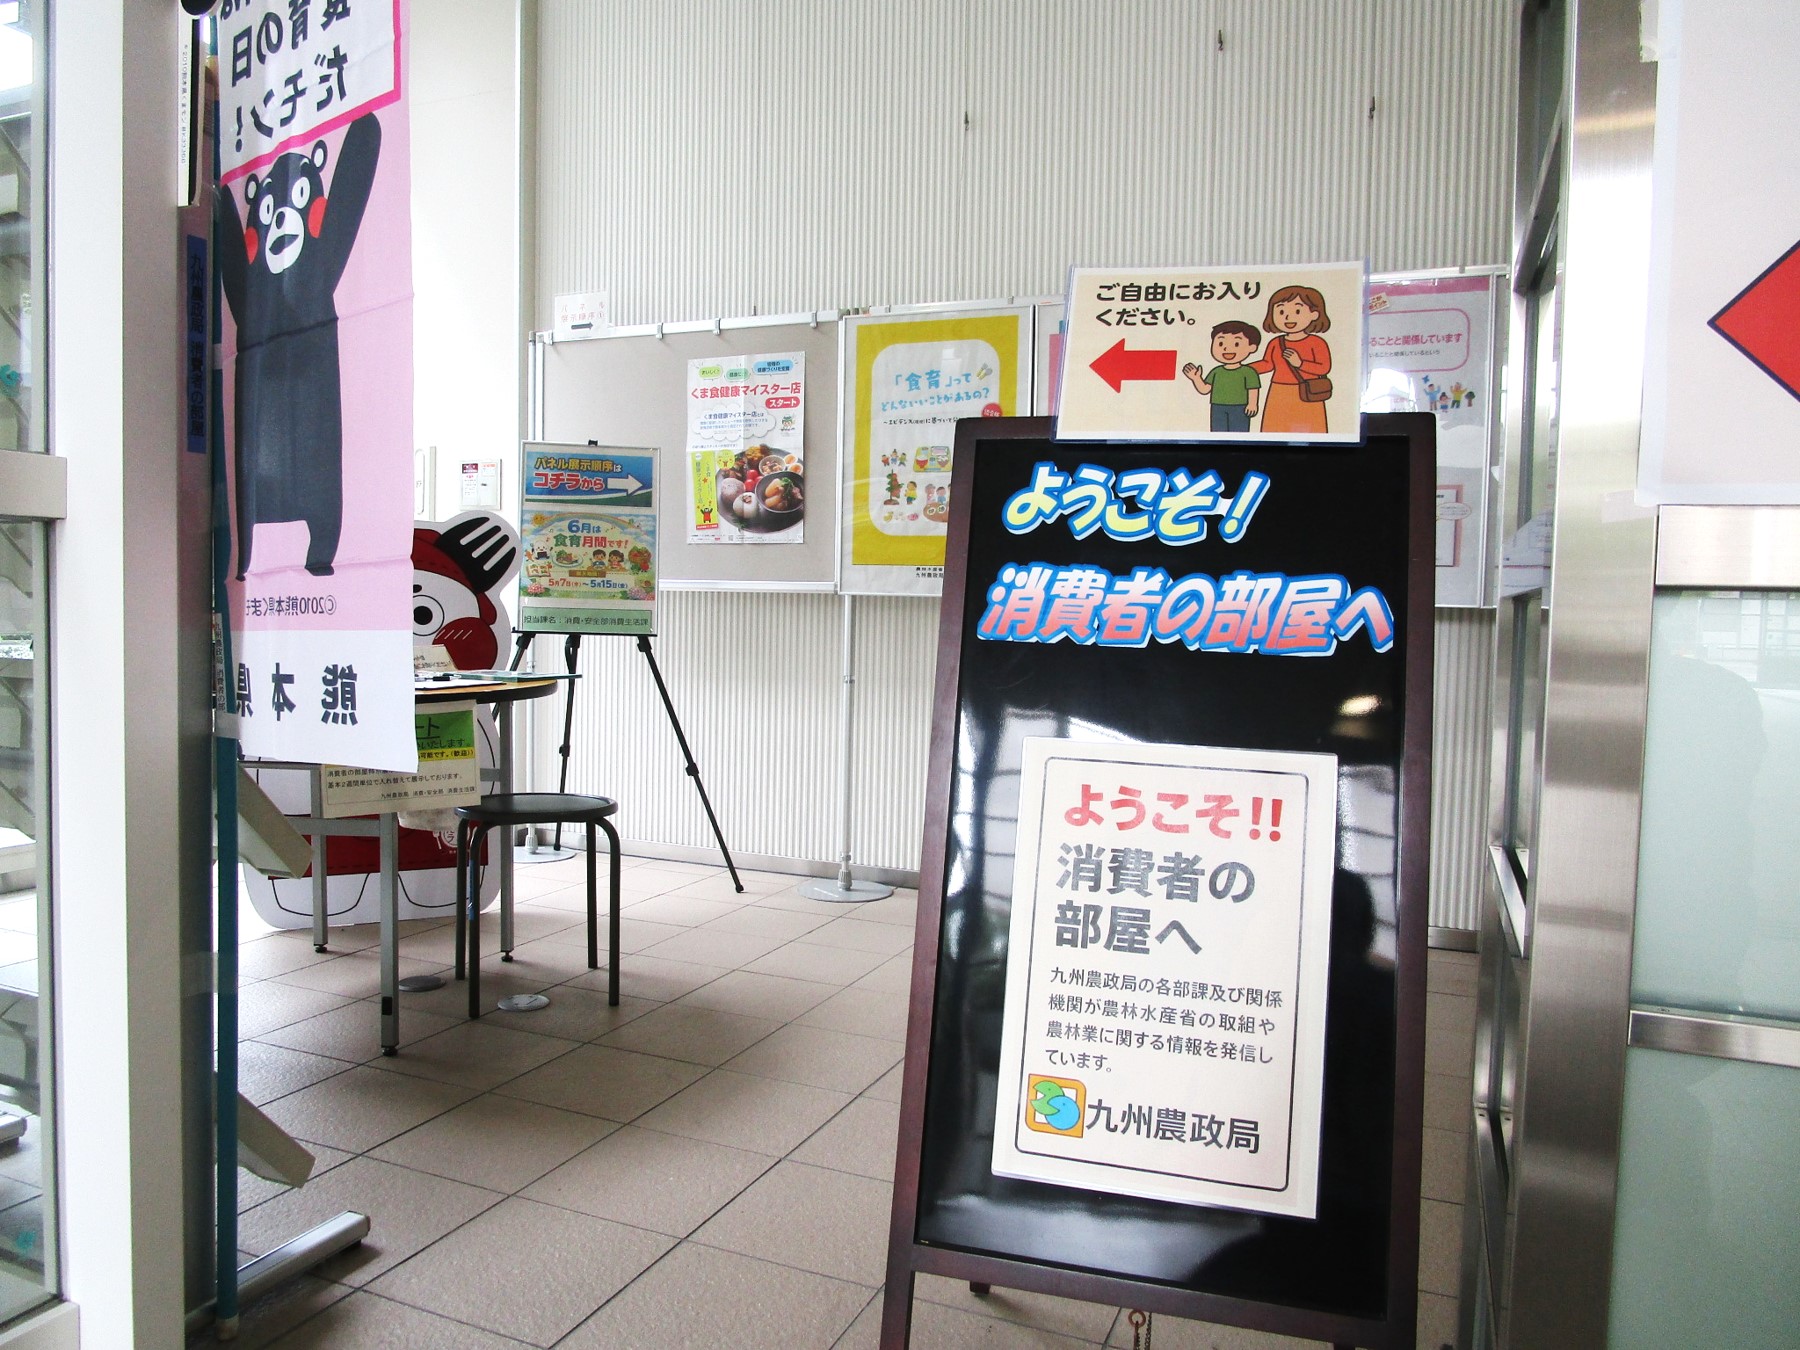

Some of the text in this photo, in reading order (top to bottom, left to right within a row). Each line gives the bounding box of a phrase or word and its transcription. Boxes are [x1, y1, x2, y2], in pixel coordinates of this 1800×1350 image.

[1096, 281, 1261, 302] ご自由にお入り
[1095, 307, 1197, 327] ください。
[691, 382, 801, 399] くま食健康マイスター店
[894, 369, 972, 392] 「食育」って
[769, 399, 797, 408] スタート
[881, 387, 990, 412] どんないいことがあるの?
[535, 458, 623, 472] パネル展示順序は
[533, 472, 605, 491] コチラから
[1002, 461, 1270, 546] ようこそ!
[567, 519, 602, 534] 6月は
[553, 533, 629, 549] 食育月間です!
[977, 561, 1394, 657] 消費者の部屋へ
[1064, 784, 1283, 842] ようこそ!!
[1055, 842, 1256, 904] 消費者の
[1054, 899, 1203, 955] 部屋へ
[1050, 967, 1283, 1009] 九州農政局の各部課及び関係
[1048, 993, 1276, 1036] 機関が農林水産省の取組や
[1046, 1020, 1274, 1064] 農林業に関する情報を発信し
[1045, 1049, 1113, 1074] ています。
[1086, 1098, 1261, 1155] 九州農政局
